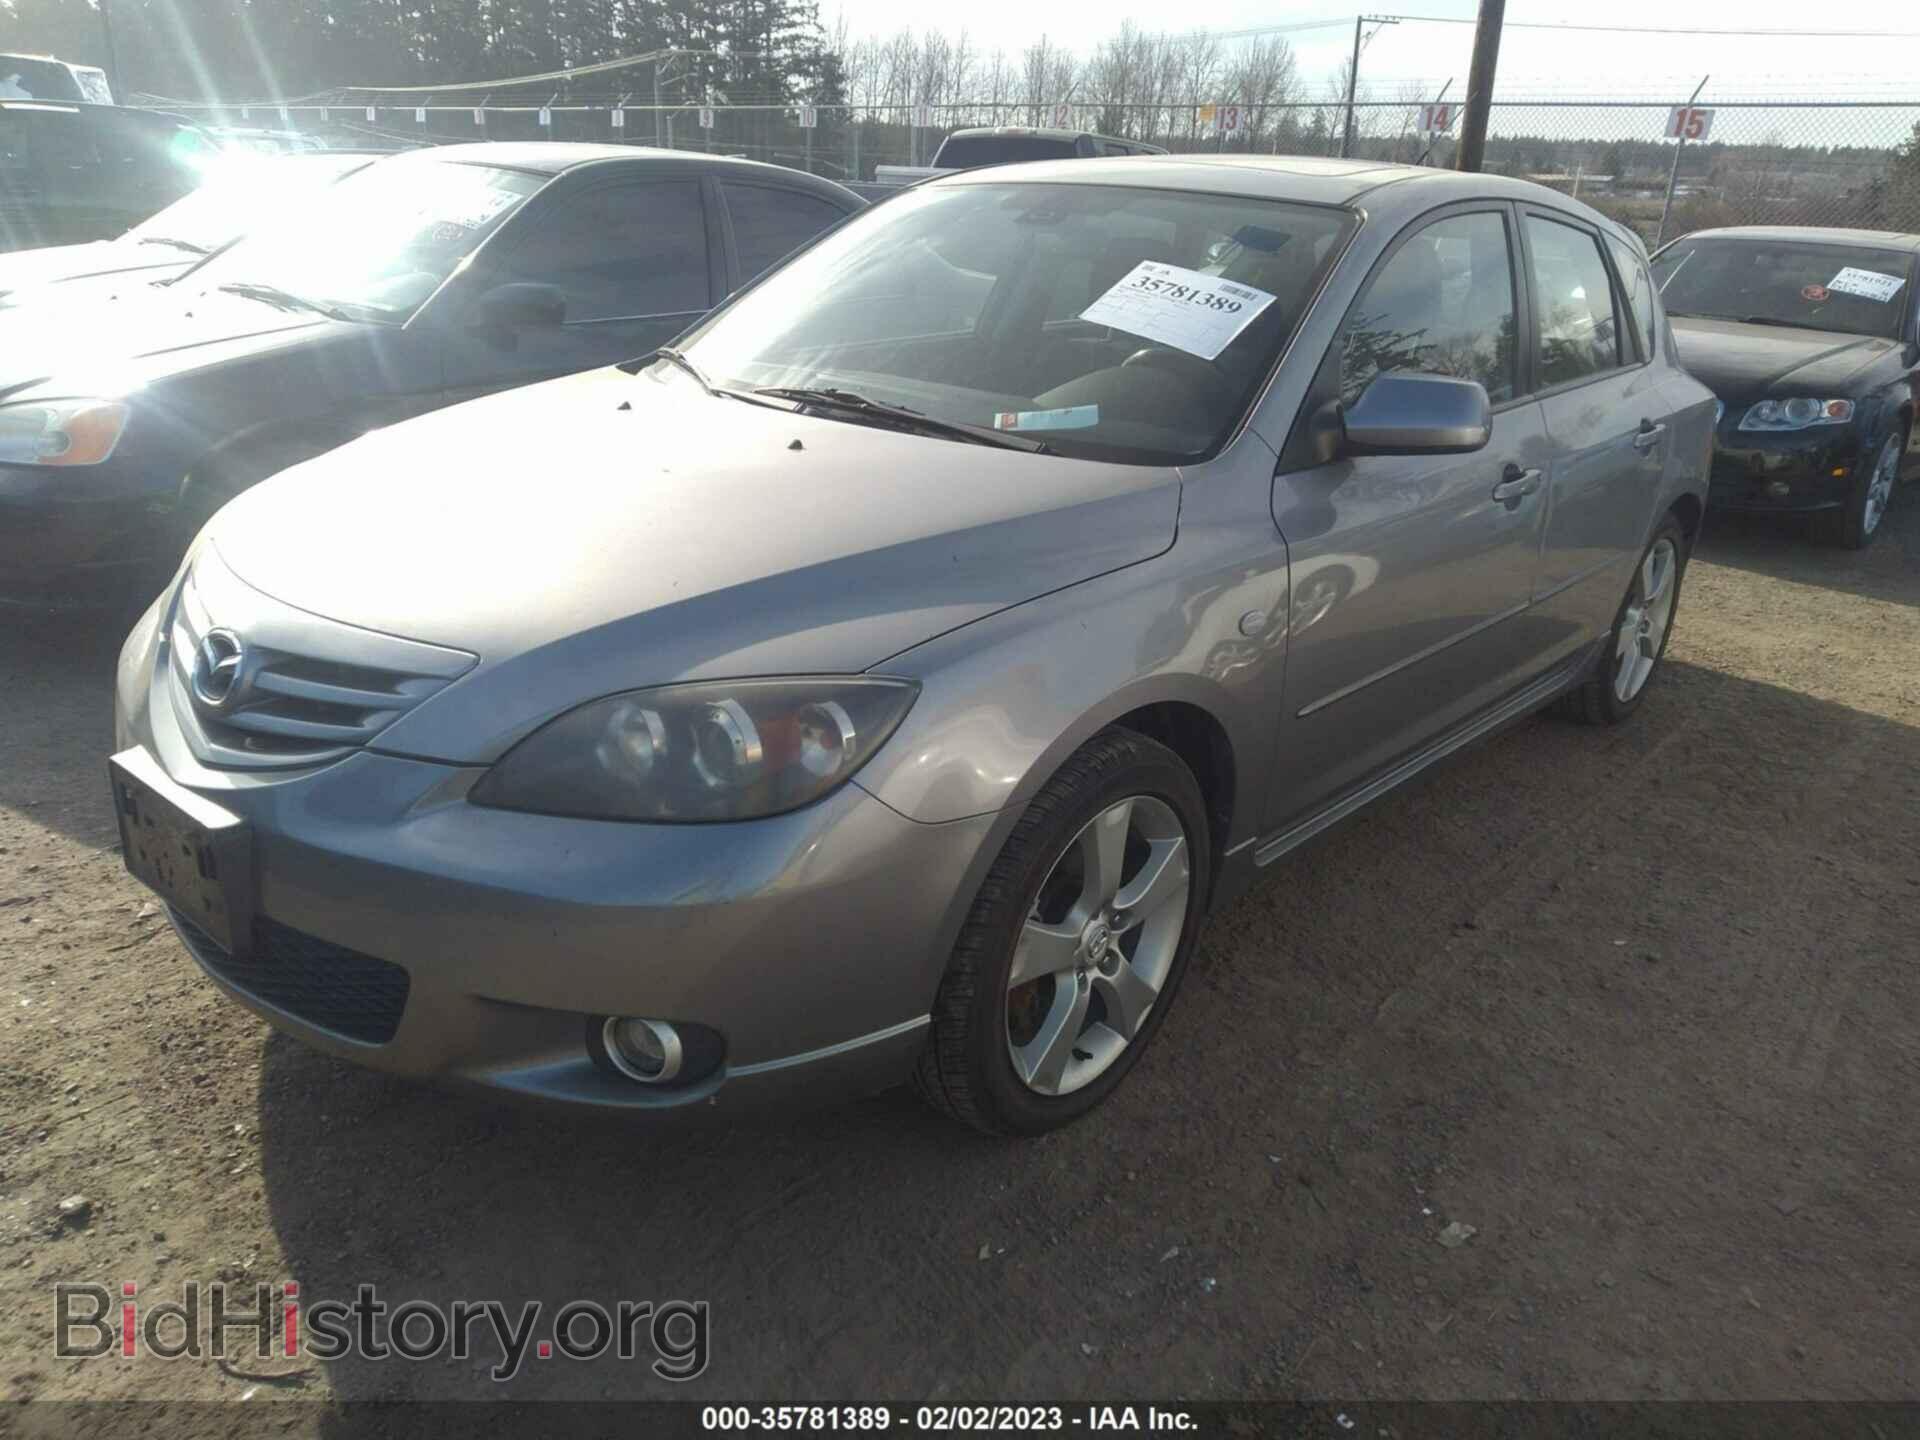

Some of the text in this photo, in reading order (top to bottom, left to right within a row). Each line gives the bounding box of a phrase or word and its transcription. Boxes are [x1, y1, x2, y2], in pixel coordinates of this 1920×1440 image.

[1220, 108, 1238, 129] 13
[1425, 106, 1449, 130] 14
[1674, 109, 1705, 139] 15
[1131, 276, 1243, 313] 35781389
